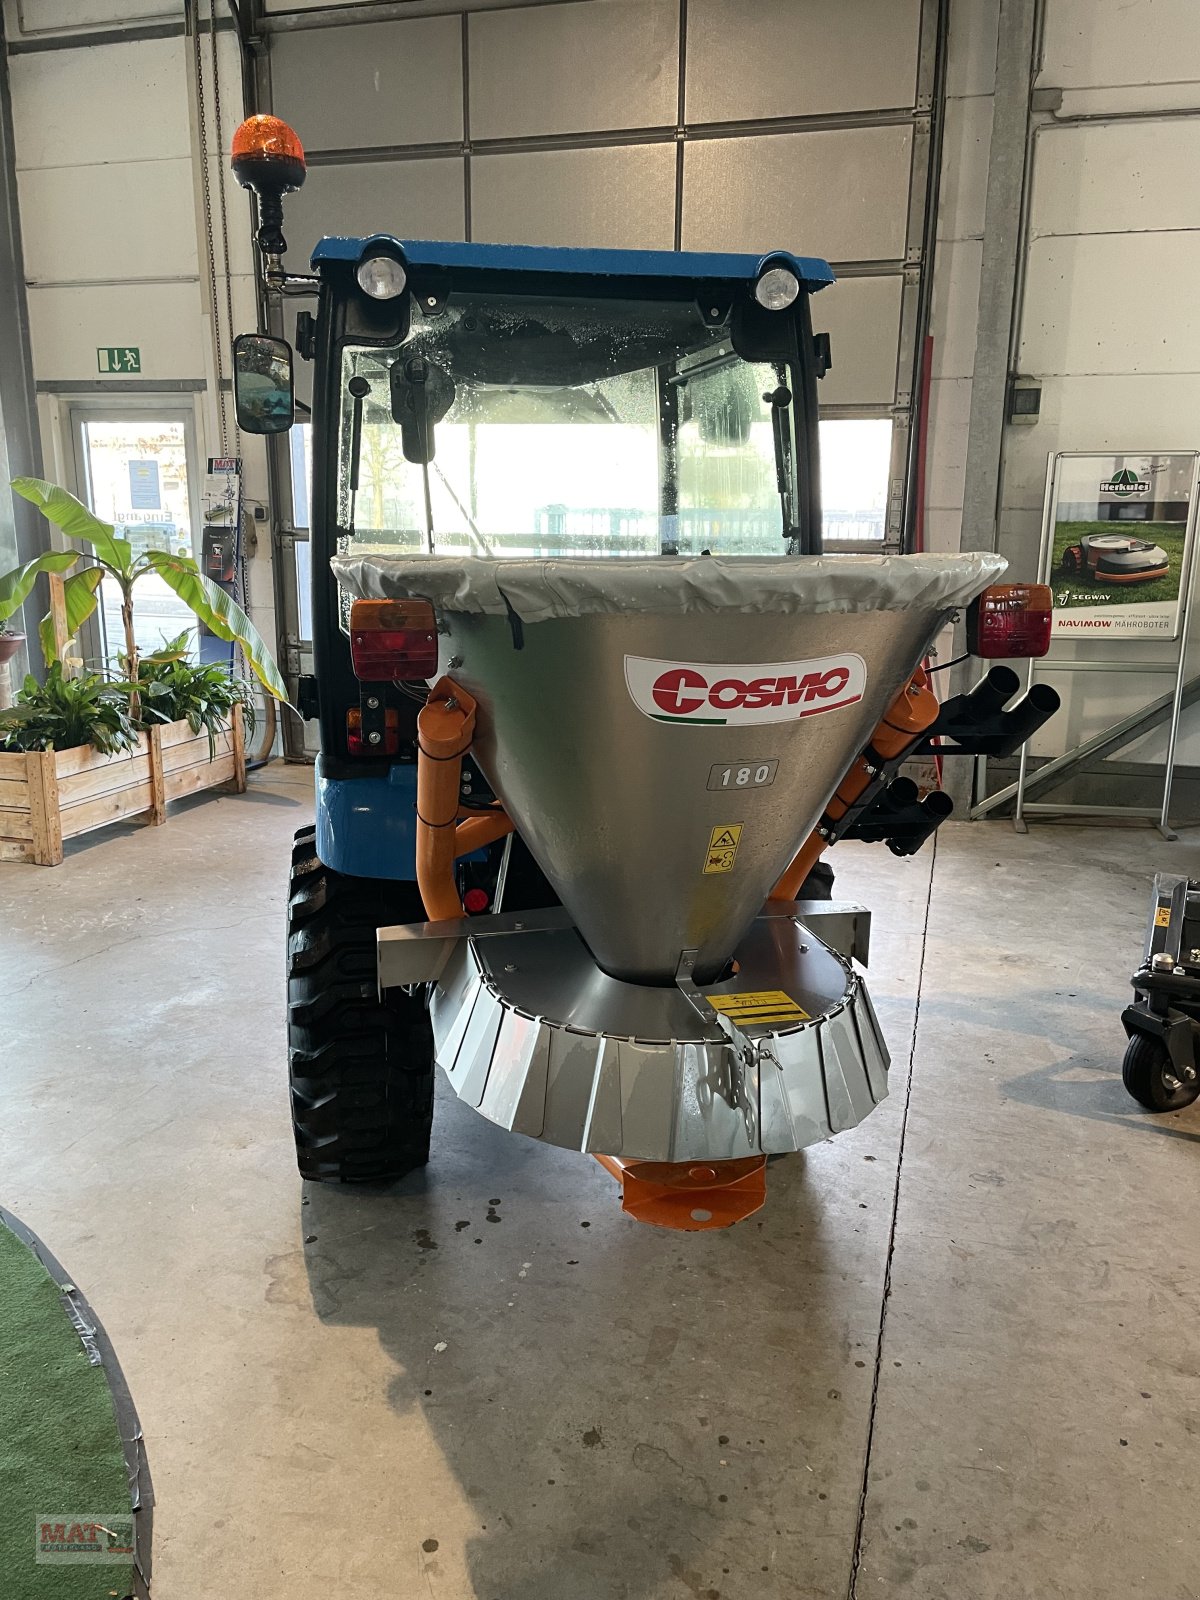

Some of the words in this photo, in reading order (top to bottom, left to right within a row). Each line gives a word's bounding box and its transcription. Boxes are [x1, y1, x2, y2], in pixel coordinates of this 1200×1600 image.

[214, 459, 235, 468] MAT
[1100, 481, 1150, 491] Herkules
[1058, 620, 1112, 628] NAVIMOW
[1114, 619, 1170, 629] MÄHROBOTER
[652, 667, 850, 714] COSMO
[720, 765, 769, 786] 180
